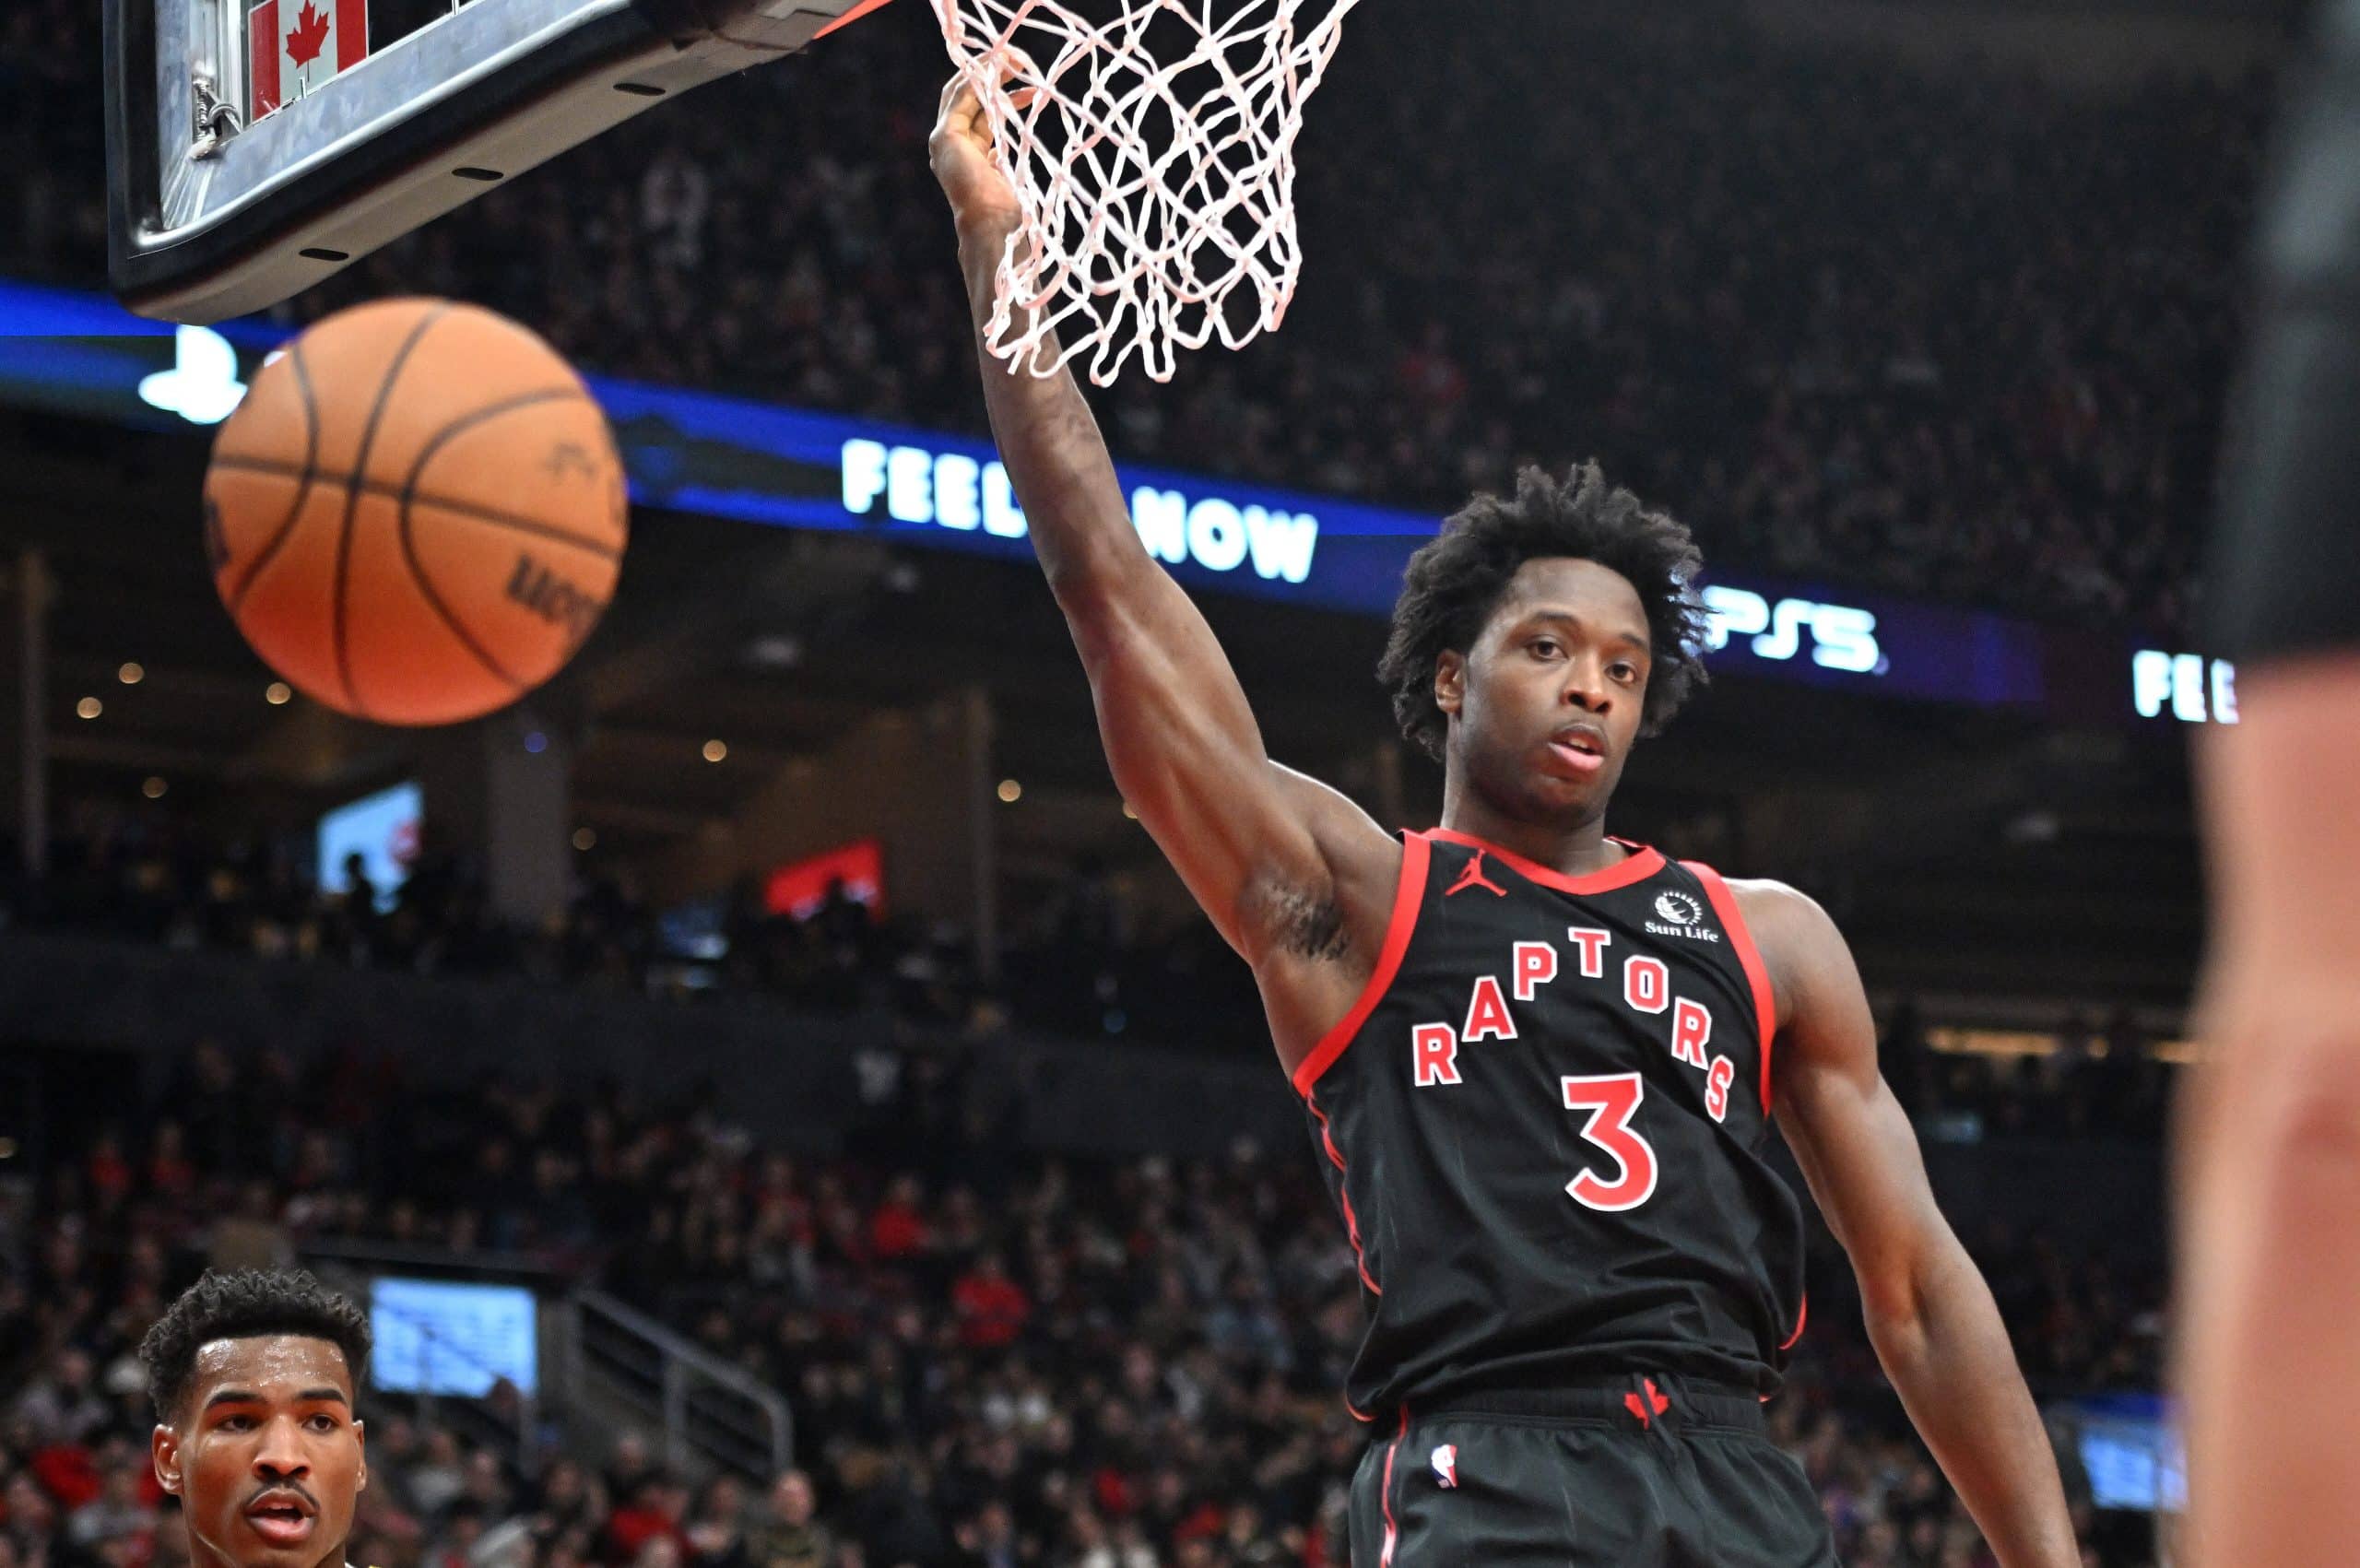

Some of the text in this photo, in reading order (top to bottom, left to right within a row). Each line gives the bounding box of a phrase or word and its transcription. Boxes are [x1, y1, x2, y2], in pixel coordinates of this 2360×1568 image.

[841, 437, 1318, 584] FEEL NOW
[1700, 584, 1879, 672] PS5
[1645, 920, 1719, 943] Sun Life
[1412, 926, 1734, 1124] RAPTORS
[1561, 1072, 1658, 1212] 3
